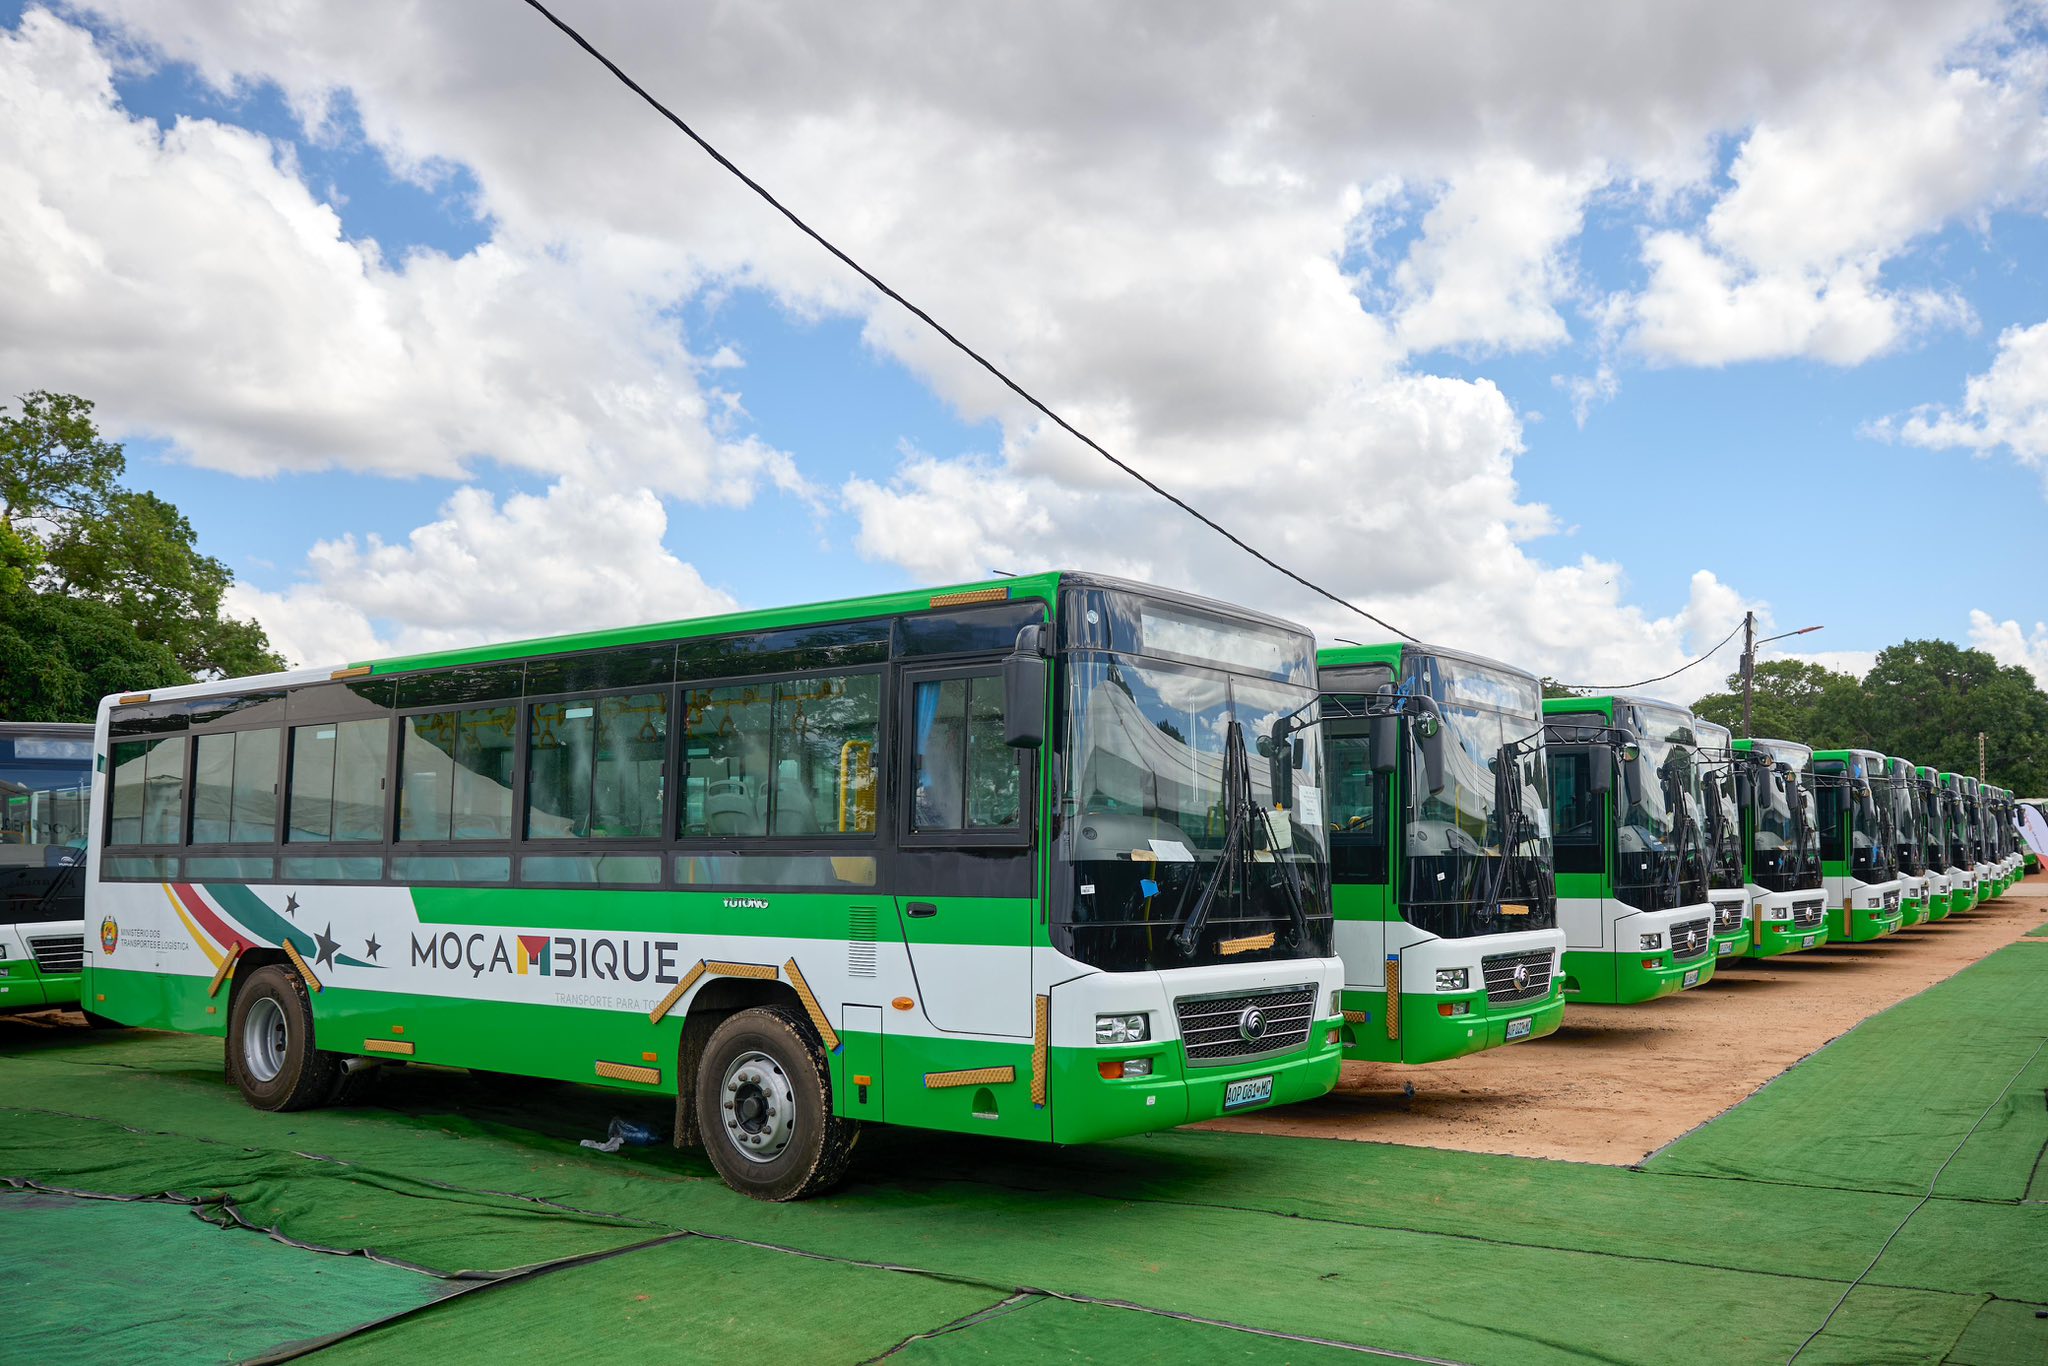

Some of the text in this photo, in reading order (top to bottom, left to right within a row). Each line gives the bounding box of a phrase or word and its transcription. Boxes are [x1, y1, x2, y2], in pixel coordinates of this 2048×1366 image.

[723, 897, 769, 909] YUTONG
[149, 929, 160, 939] DOS
[121, 938, 156, 949] TRANSPORTES
[411, 931, 679, 984] MOÇAMBIQUE
[555, 992, 613, 1008] TRANSPORTE
[616, 997, 641, 1010] PARA
